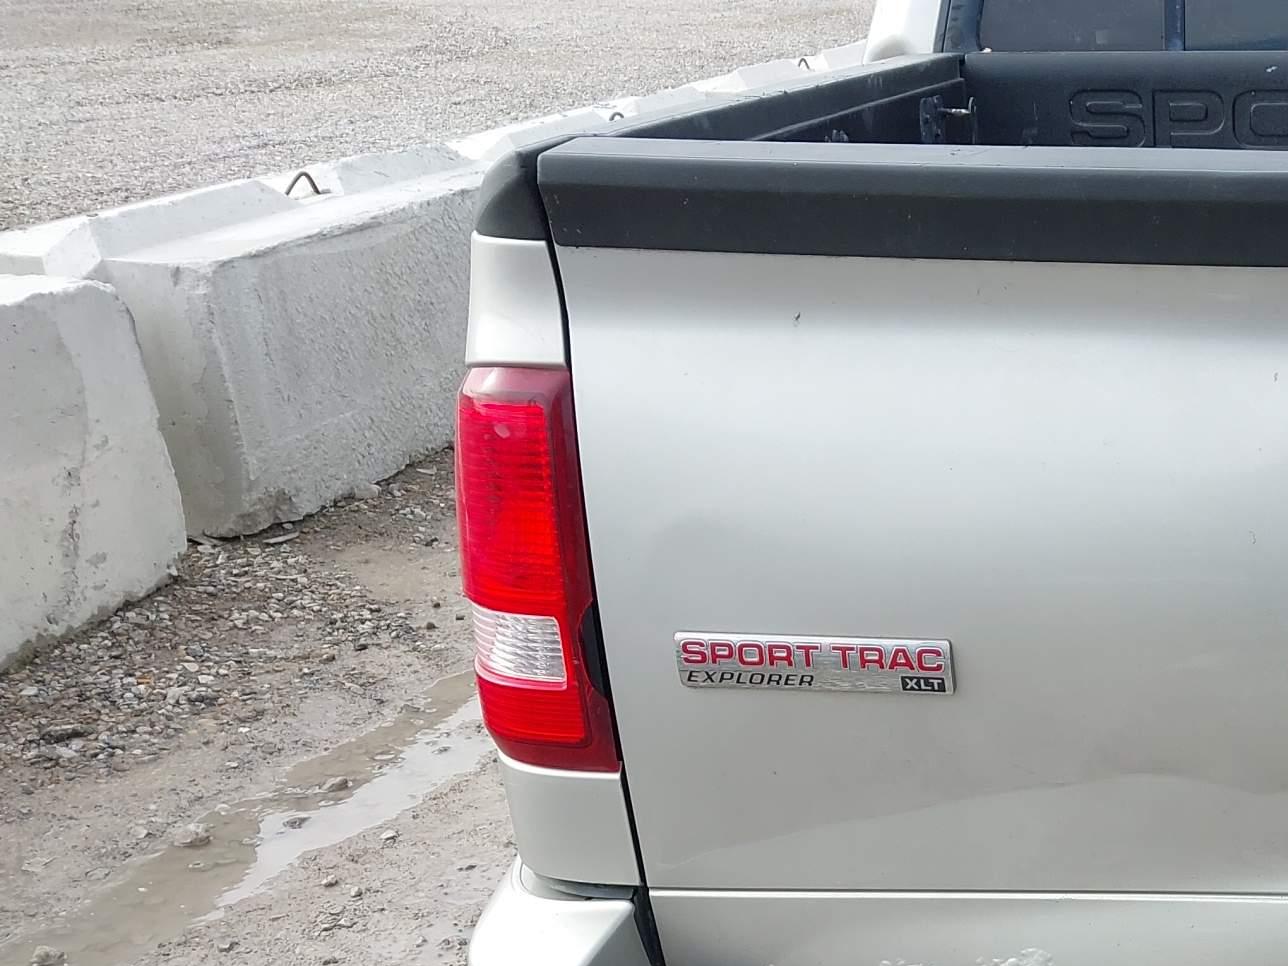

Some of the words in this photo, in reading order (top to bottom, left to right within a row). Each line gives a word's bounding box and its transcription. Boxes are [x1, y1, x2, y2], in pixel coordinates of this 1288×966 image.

[680, 640, 821, 668] SPORT
[831, 644, 945, 673] TRAC
[687, 670, 814, 687] EXPLORER
[904, 677, 945, 692] XLT
